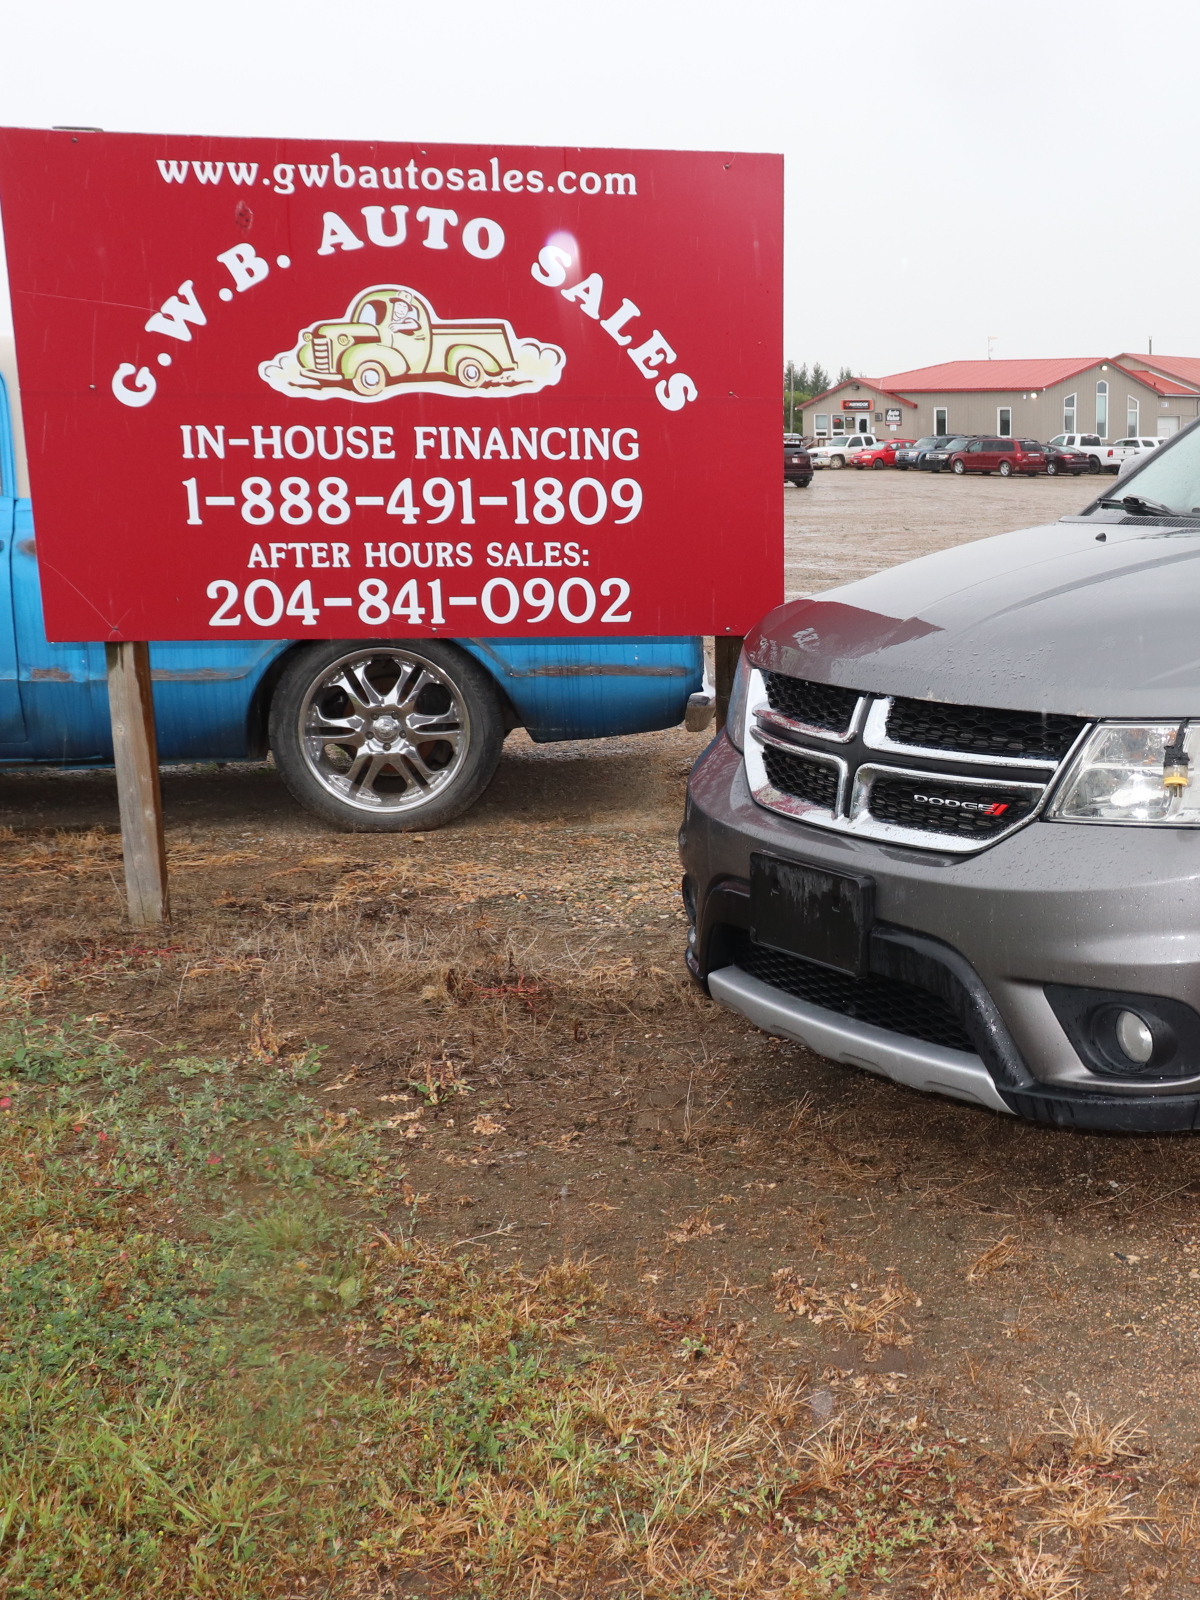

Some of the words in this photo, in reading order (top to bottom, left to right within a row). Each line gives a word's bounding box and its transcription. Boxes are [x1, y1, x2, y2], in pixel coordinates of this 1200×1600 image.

[156, 152, 638, 196] www.gwbautosales.com
[111, 242, 291, 408] G.W.B.
[317, 204, 505, 260] AUTO
[530, 244, 699, 412] SALES
[180, 424, 395, 461] IN-HOUSE
[414, 426, 640, 461] FINANCING
[182, 477, 643, 526] 1-888-491-1809
[248, 542, 351, 569] AFTER
[364, 541, 473, 569] HOURS
[487, 541, 591, 569] SALES:
[207, 577, 632, 627] 204-841-0902
[913, 794, 995, 813] DODGE
